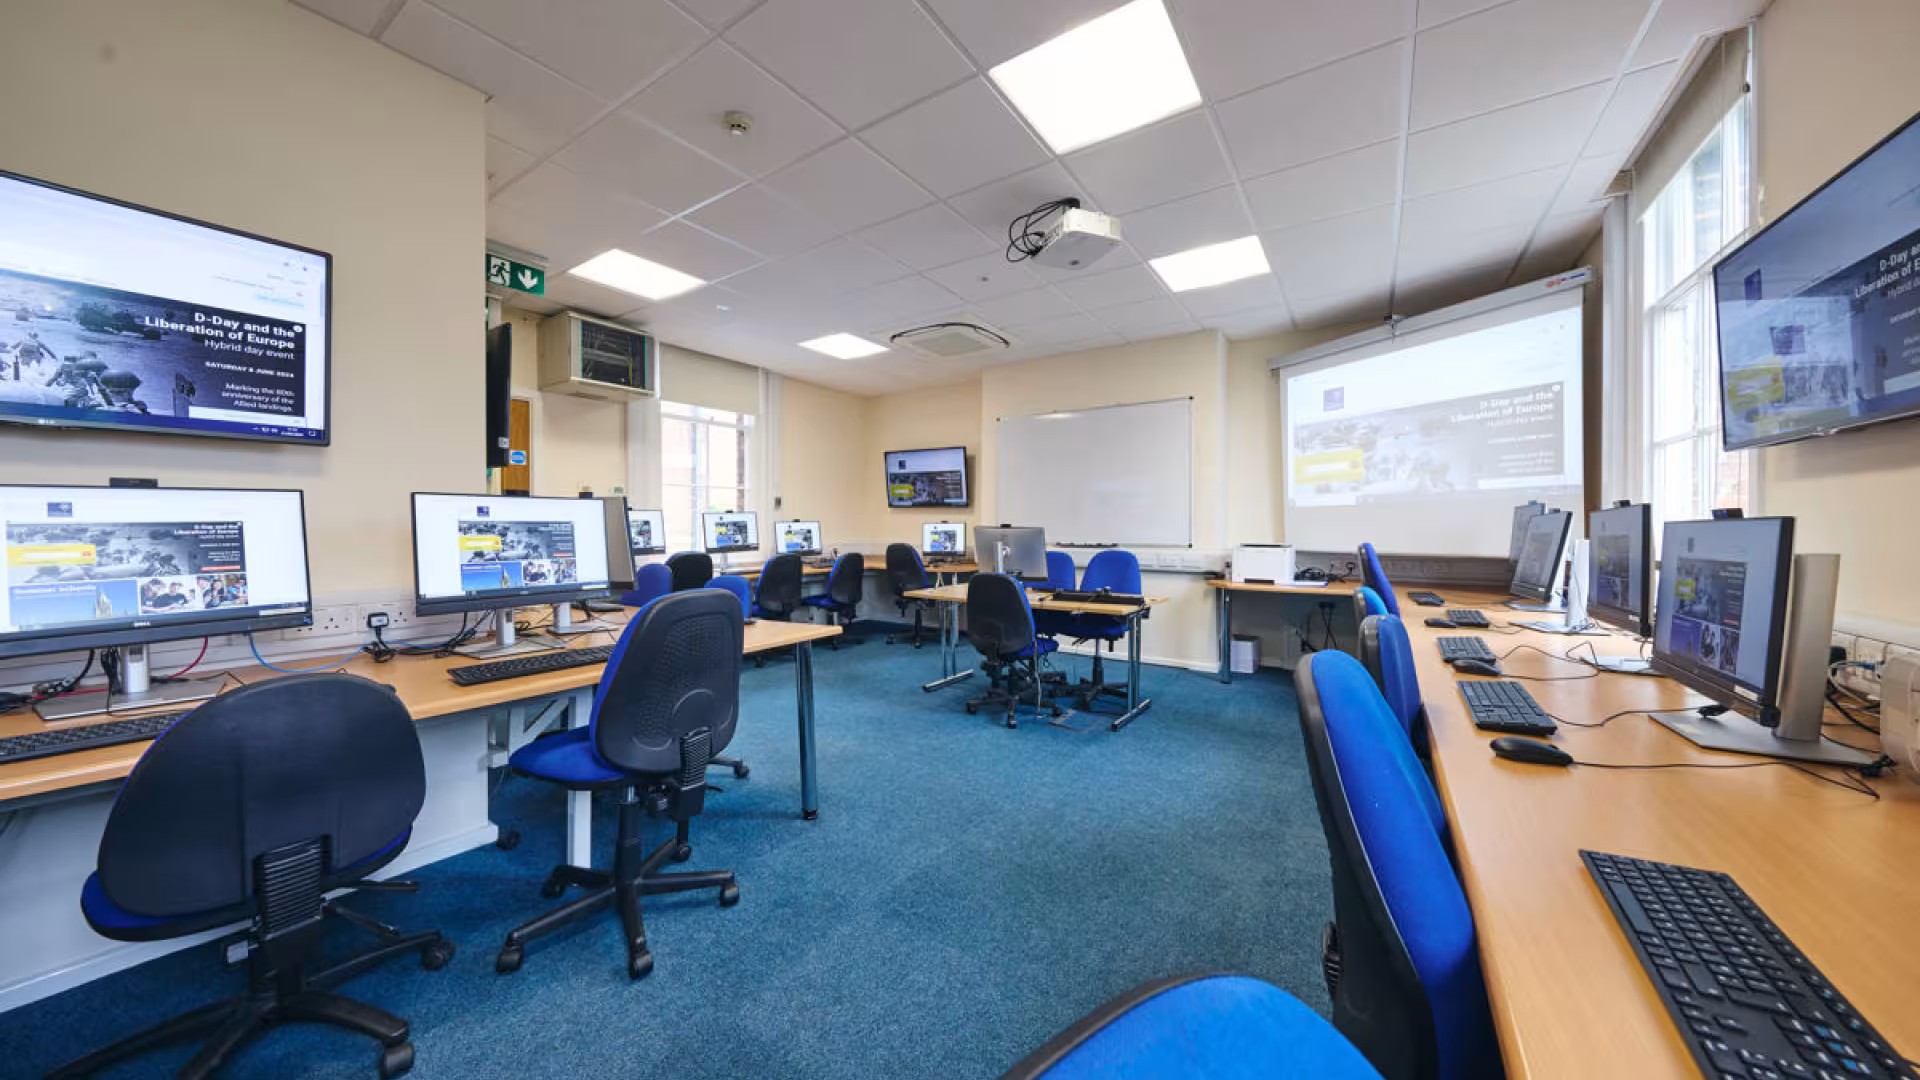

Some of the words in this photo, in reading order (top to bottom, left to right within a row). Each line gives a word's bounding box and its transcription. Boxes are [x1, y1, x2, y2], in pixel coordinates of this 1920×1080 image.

[1879, 250, 1909, 271] D-Day
[1855, 271, 1899, 298] Liberation
[1901, 262, 1911, 276] of
[145, 316, 224, 338] Liberation
[228, 331, 244, 340] of
[247, 333, 295, 349] Europe
[194, 312, 240, 330] D-Day
[243, 322, 269, 334] and
[273, 326, 295, 338] the
[204, 339, 241, 352] Hybrid
[244, 345, 264, 357] day
[266, 350, 295, 360] event
[226, 382, 260, 394] Marking
